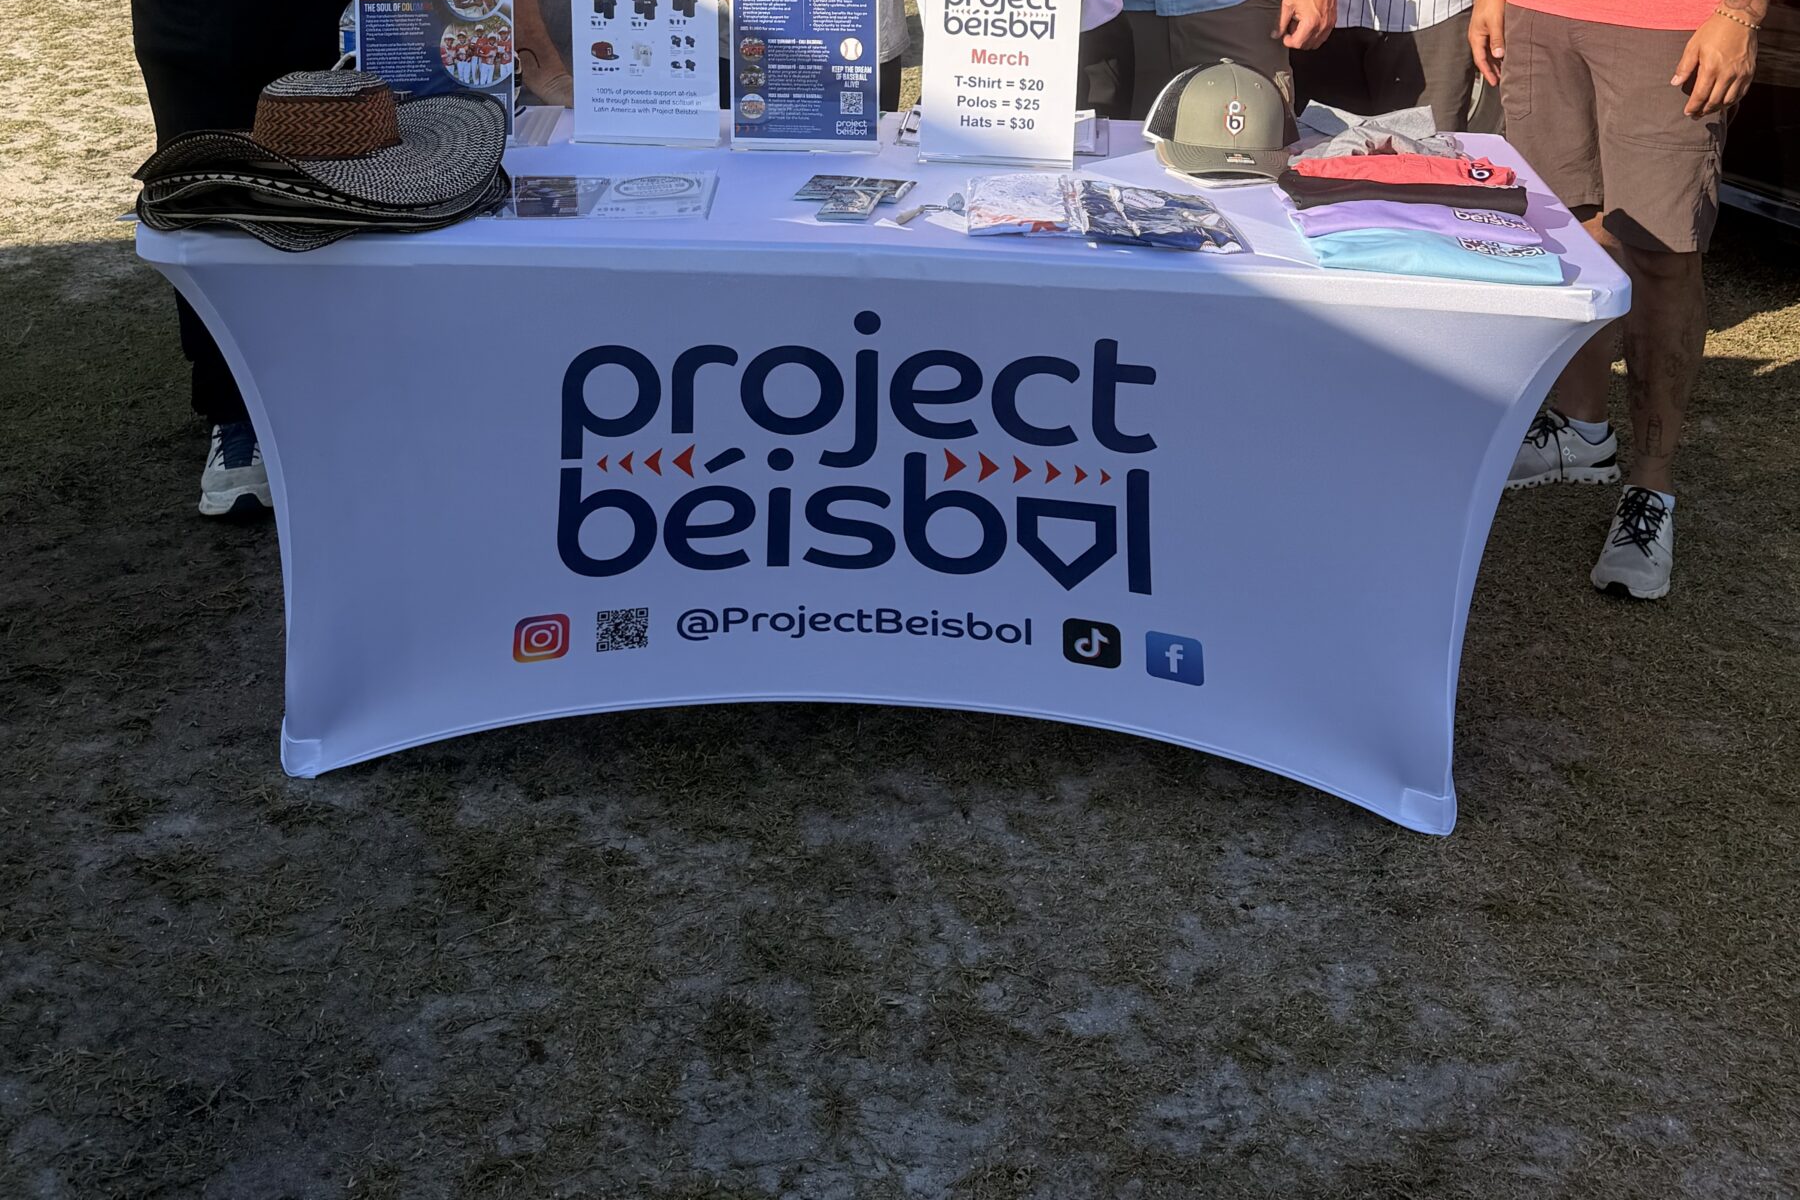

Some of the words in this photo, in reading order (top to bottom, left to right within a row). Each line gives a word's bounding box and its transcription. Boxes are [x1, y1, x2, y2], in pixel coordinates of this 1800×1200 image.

[364, 3, 375, 12] THE
[376, 3, 392, 12] SOUL
[393, 3, 401, 11] OF
[943, 9, 1056, 40] béisbol
[971, 48, 1030, 67] Merch
[855, 66, 872, 74] DREAM
[954, 75, 1002, 89] T-Shirt
[1019, 79, 1045, 91] $20
[606, 97, 630, 105] through
[957, 95, 997, 109] Polos
[1015, 98, 1040, 111] $25
[836, 119, 867, 130] project
[960, 115, 992, 128] Hats
[1010, 117, 1035, 130] $30
[561, 310, 1158, 469] project
[556, 446, 1153, 596] béisbol
[676, 605, 1033, 647] @ProjectBeisbol
